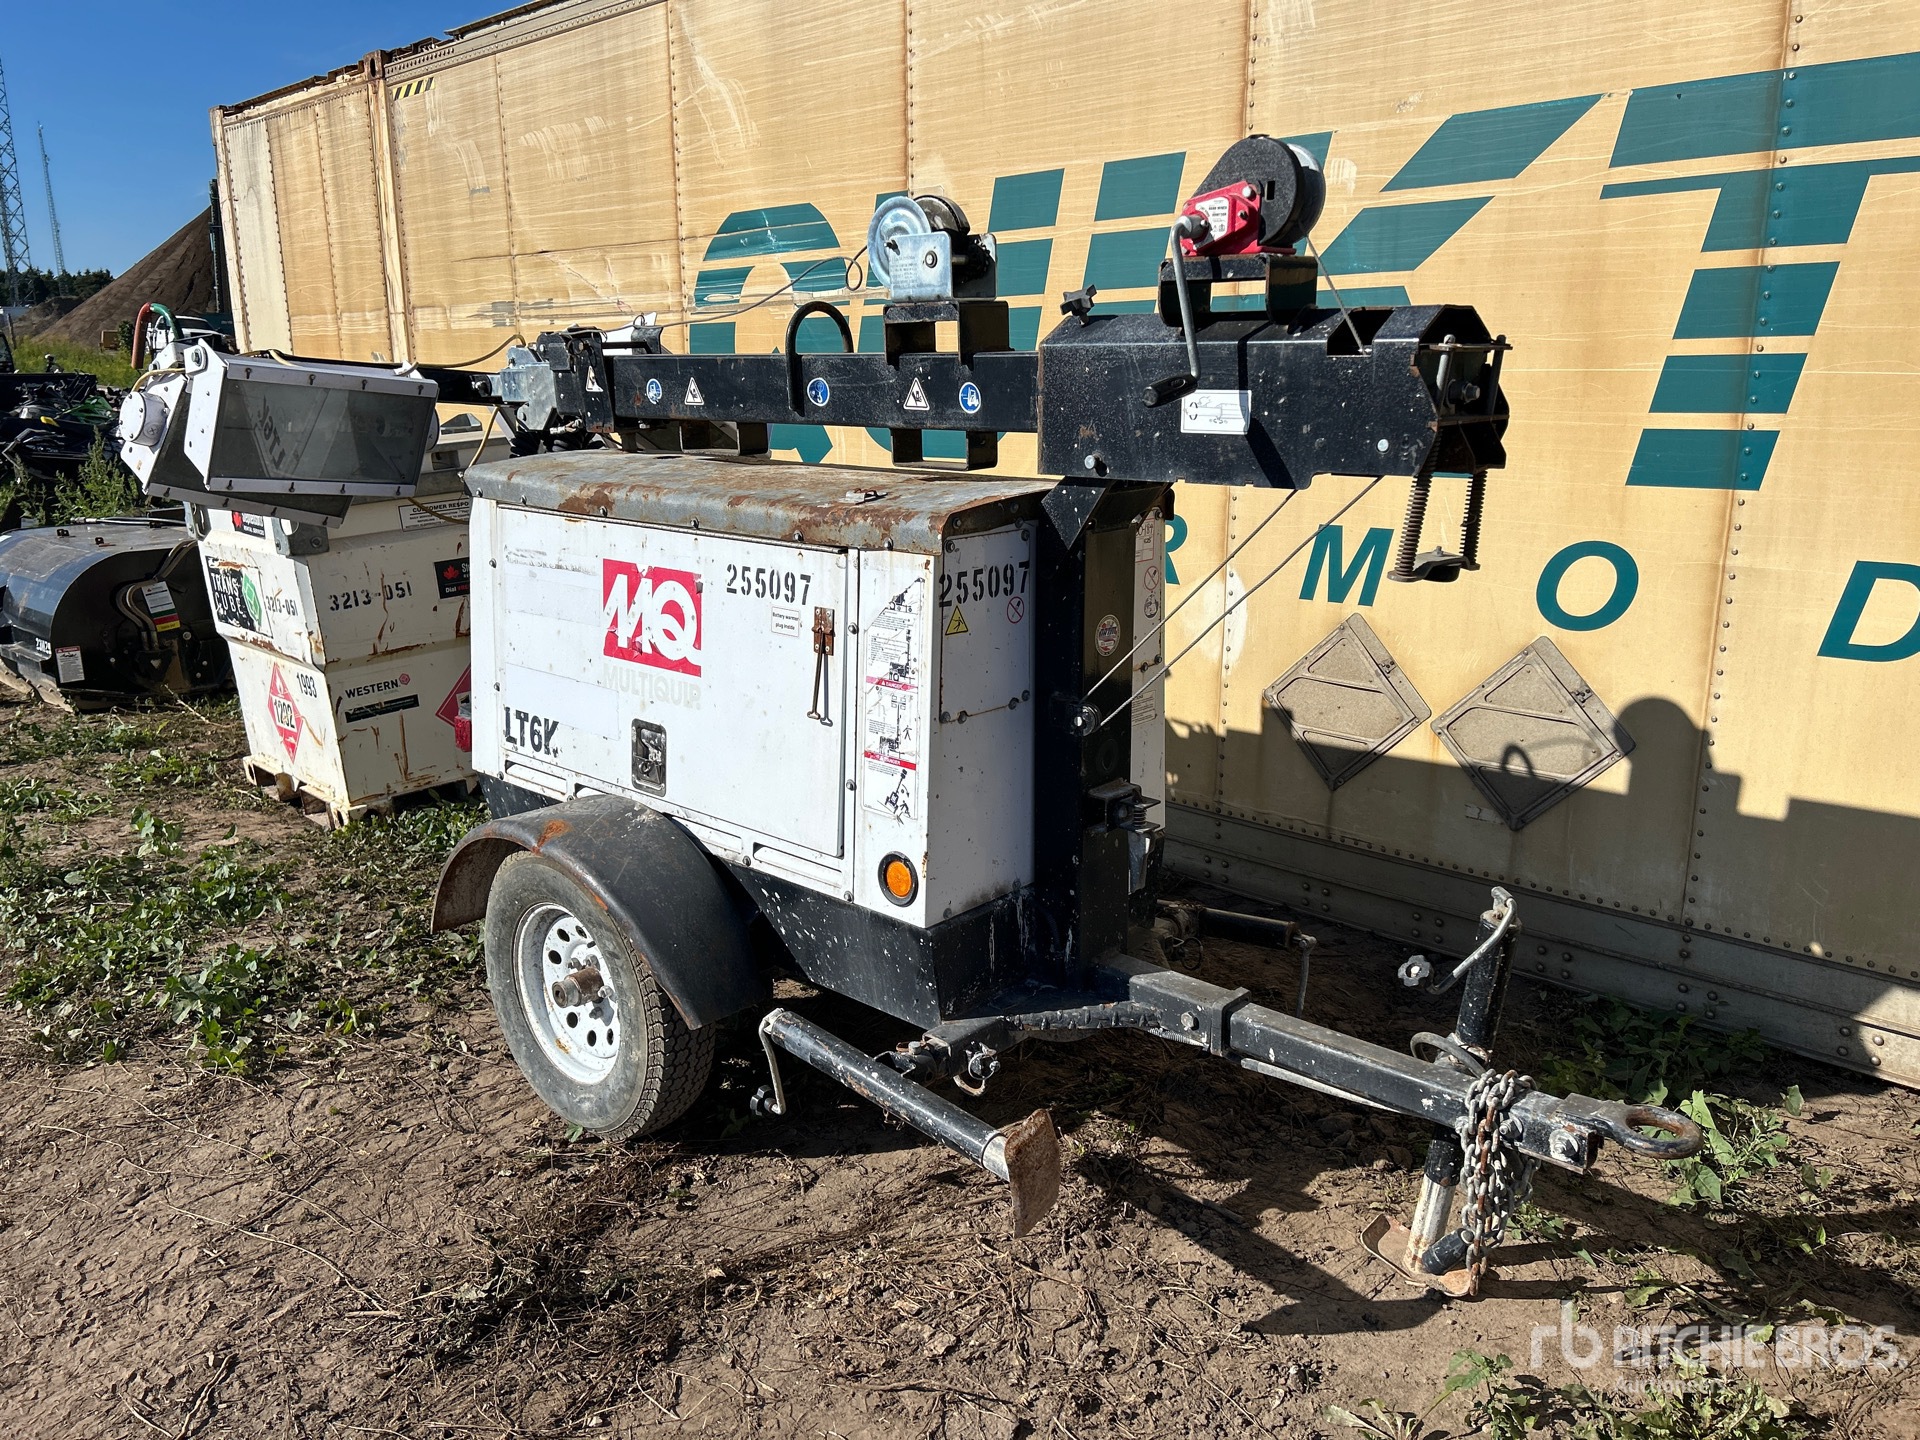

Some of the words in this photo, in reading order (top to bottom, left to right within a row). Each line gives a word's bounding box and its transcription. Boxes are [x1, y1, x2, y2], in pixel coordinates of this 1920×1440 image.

[412, 504, 447, 513] CUOMER
[461, 562, 470, 573] St
[329, 581, 412, 611] 3213-051
[726, 563, 812, 606] 255097
[939, 560, 1030, 608] 255097
[265, 595, 298, 616] 3213-051
[603, 573, 702, 667] MQ
[296, 672, 318, 698] 1993
[345, 679, 399, 699] WESTERN
[504, 706, 560, 758] LT6K
